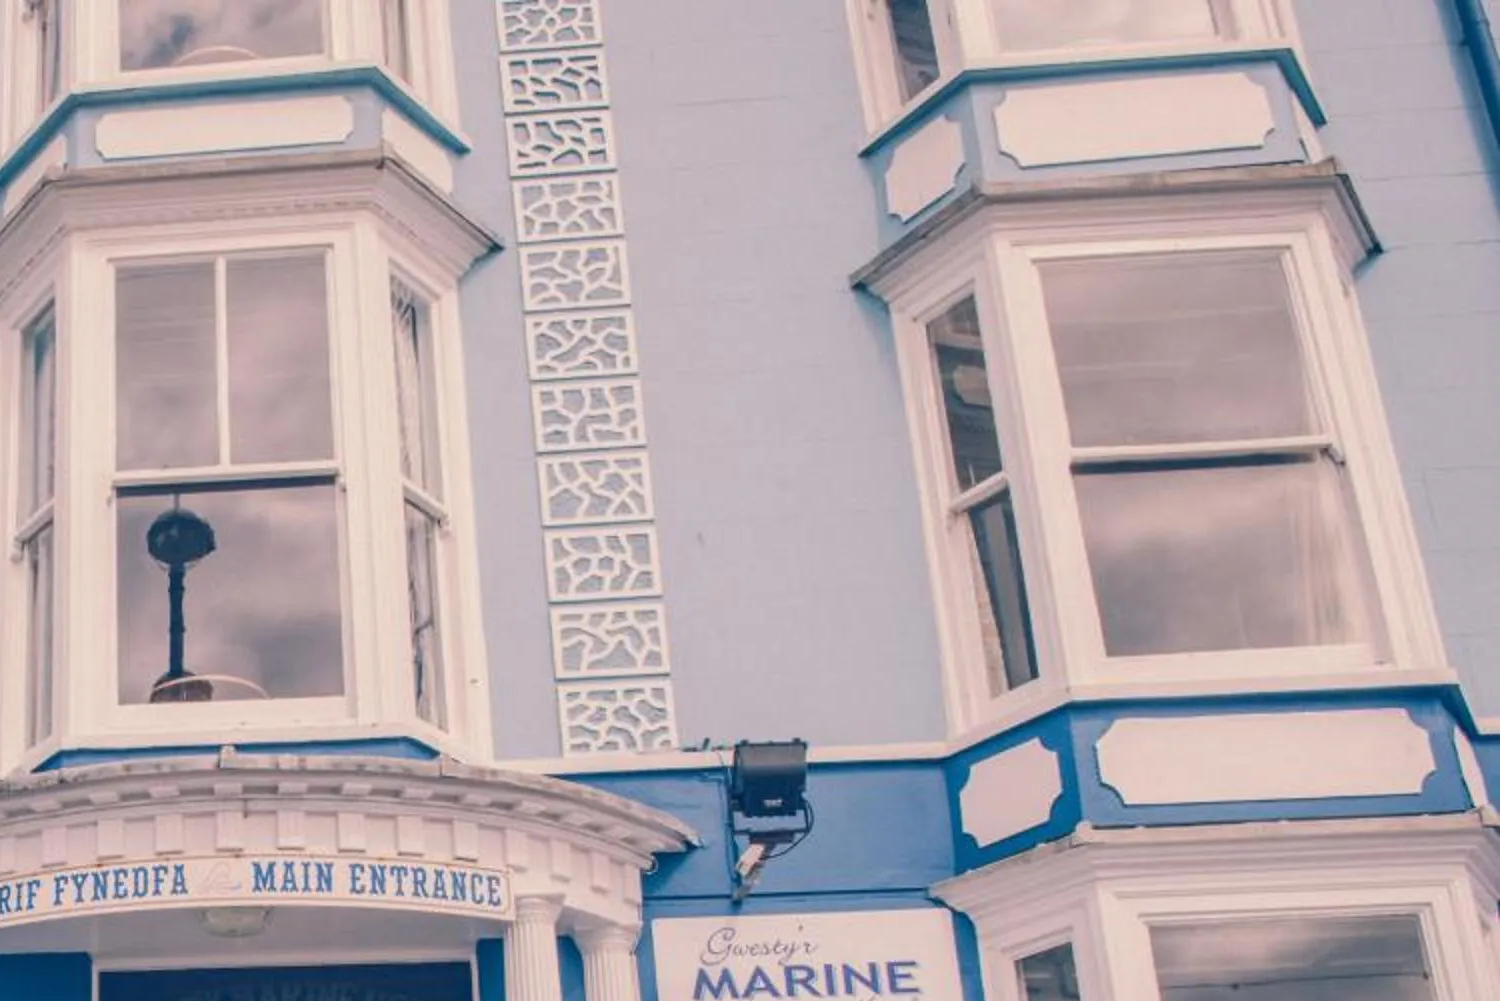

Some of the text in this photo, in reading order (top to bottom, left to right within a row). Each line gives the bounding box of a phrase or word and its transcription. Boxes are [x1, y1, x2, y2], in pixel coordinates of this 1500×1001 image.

[53, 863, 189, 906] FYNEDFA
[251, 861, 335, 893] MAIN
[349, 863, 502, 907] ENTRANCE
[693, 960, 922, 1001] MARINE
